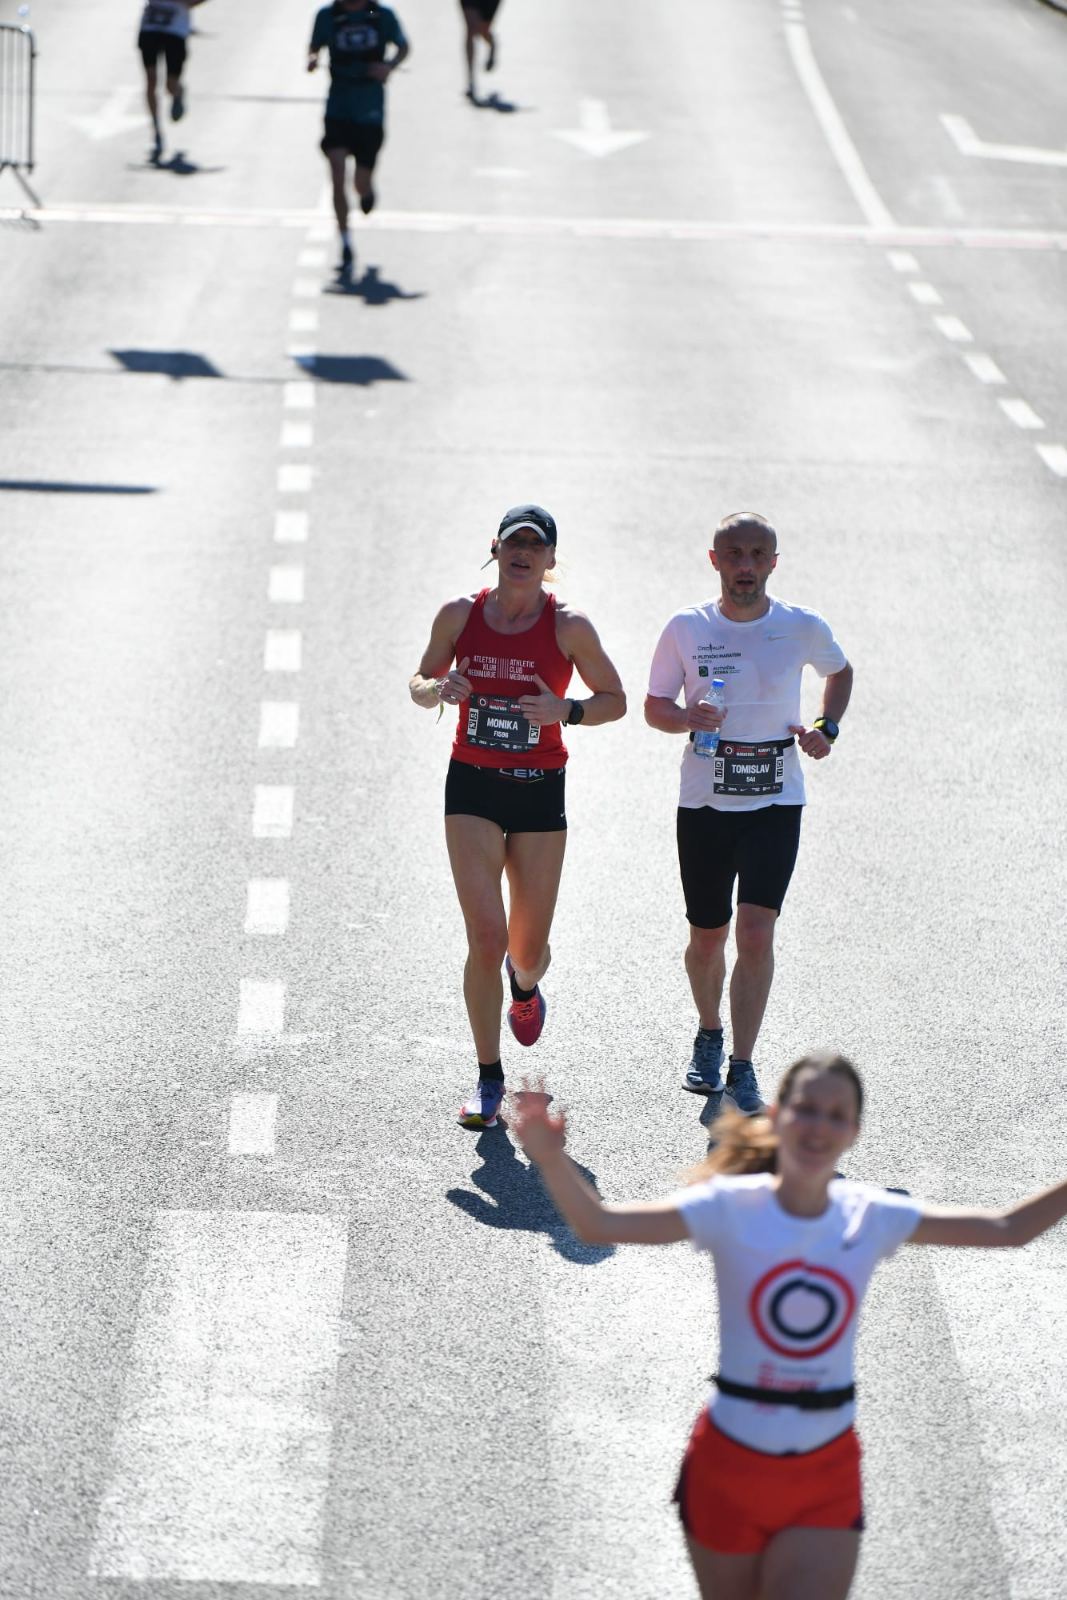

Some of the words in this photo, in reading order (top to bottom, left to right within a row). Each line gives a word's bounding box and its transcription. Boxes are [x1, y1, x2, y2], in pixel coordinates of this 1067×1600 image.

[474, 655, 497, 664] ATLETSKI
[510, 658, 535, 668] ATHLETIC
[483, 663, 497, 671] KLUB
[510, 666, 523, 674] CLUB
[486, 717, 518, 730] MONIKA
[731, 763, 770, 774] TOMISLAV
